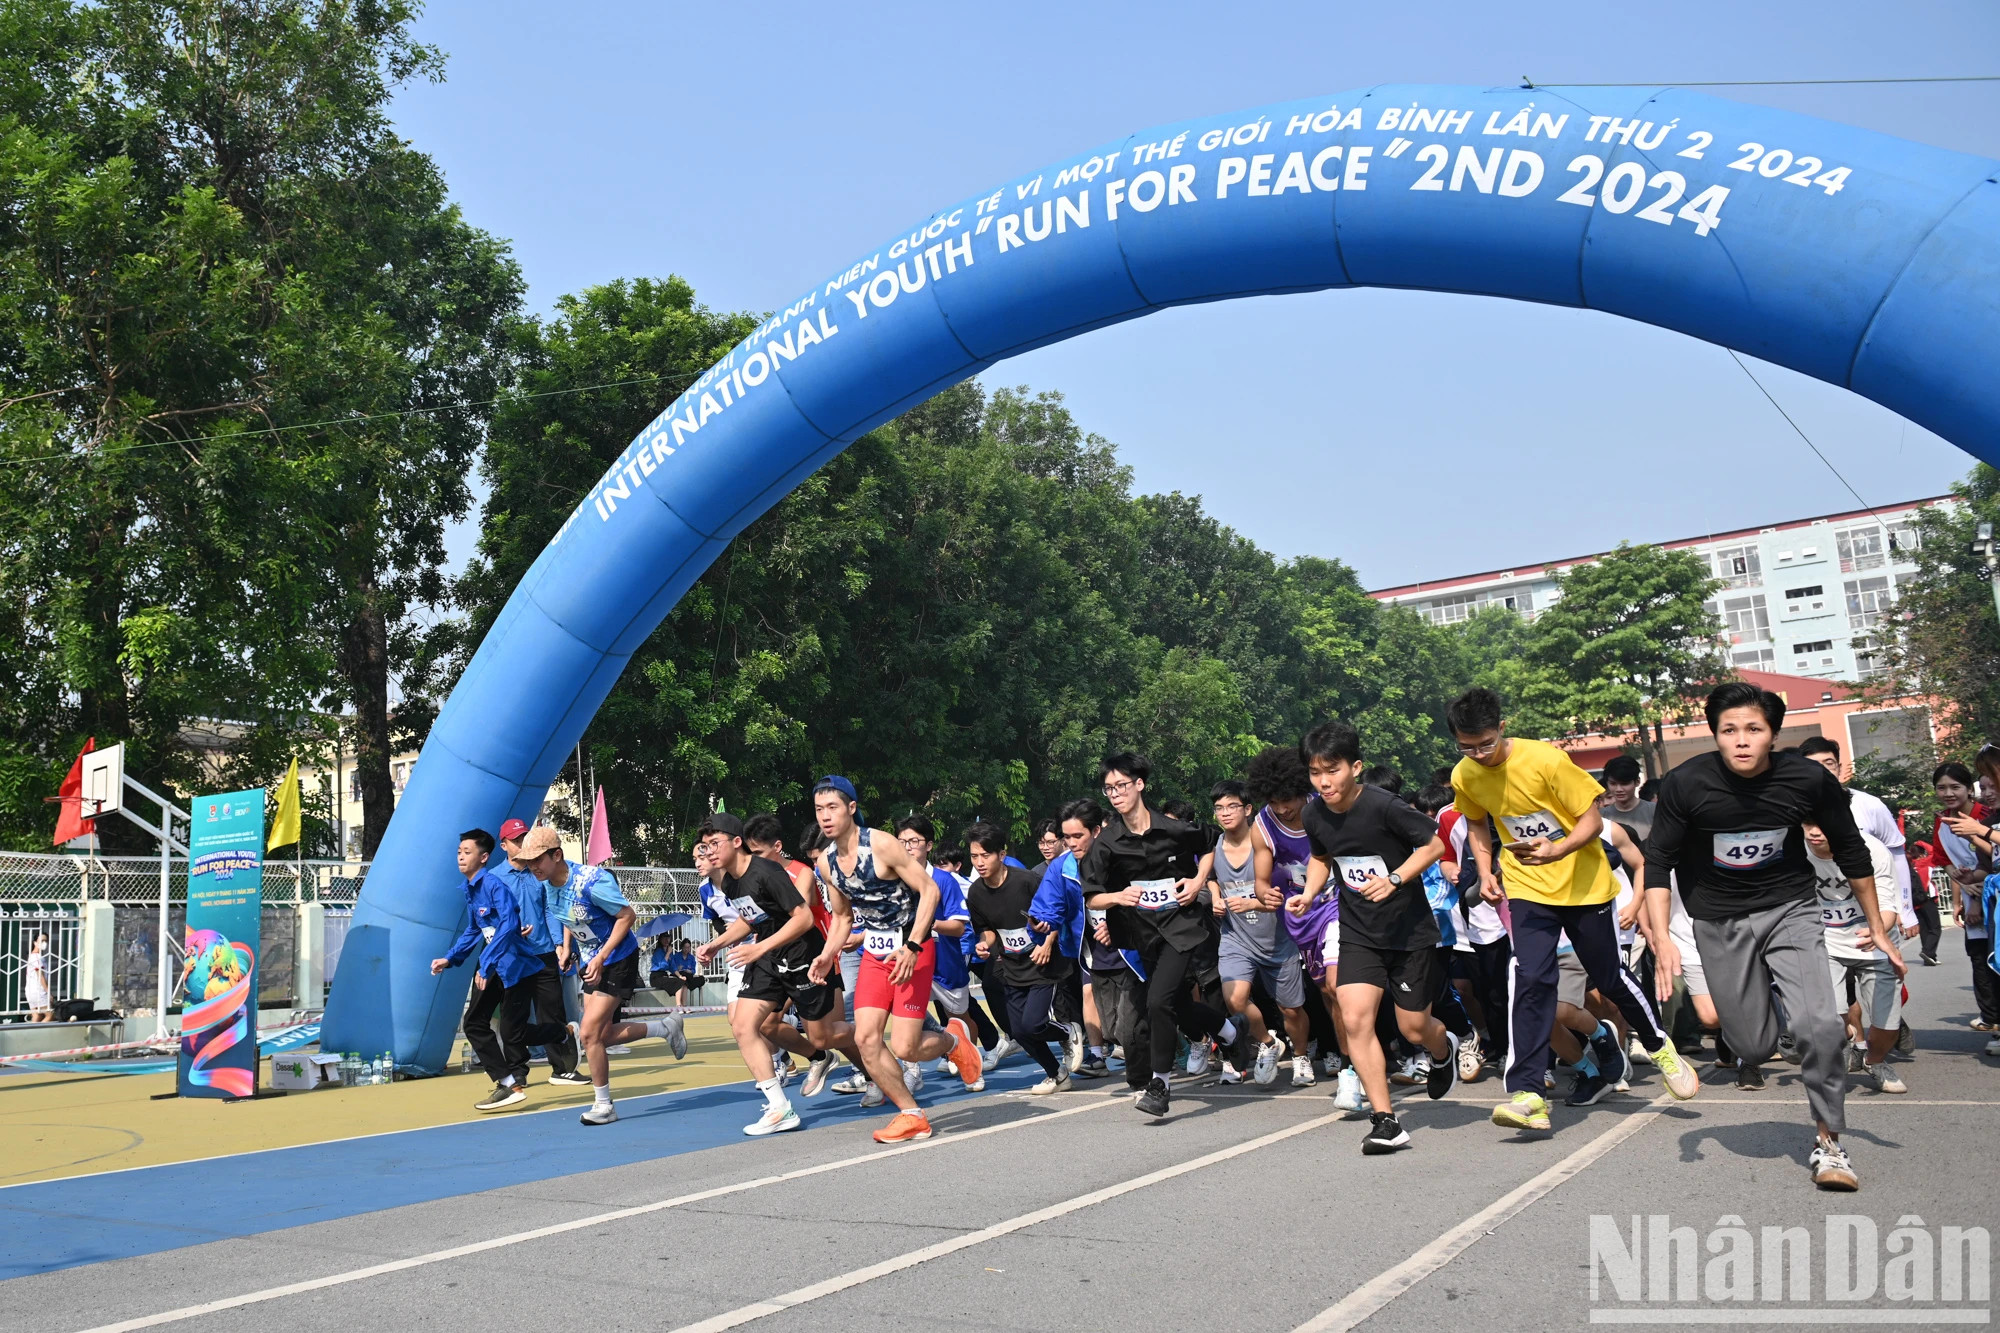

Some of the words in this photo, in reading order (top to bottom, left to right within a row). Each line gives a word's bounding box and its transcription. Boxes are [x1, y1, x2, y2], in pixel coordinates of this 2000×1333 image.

[744, 291, 816, 353] THANH
[825, 253, 880, 297] NIÊN
[888, 208, 963, 259] QUỐC
[976, 188, 1005, 216] TẾ
[1053, 152, 1120, 190] MỘT
[1132, 130, 1190, 166] THẾ
[1198, 115, 1272, 152] GIỚI
[1285, 104, 1362, 136] HÒA
[1376, 102, 1473, 135] BÌNH
[1482, 102, 1570, 139] LẦN
[1584, 115, 1680, 151] THỨ
[1676, 131, 1714, 160] 2
[1726, 142, 1853, 196] 2024
[594, 307, 838, 522] INTERNATIONAL
[845, 231, 974, 320] YOUTH
[1105, 163, 1198, 222] FOR
[1556, 154, 1731, 238] 2024
[1514, 821, 1549, 838] 264
[195, 851, 237, 865] INTERNATIONAL
[237, 850, 257, 859] YOUTH
[1726, 843, 1774, 860] 495
[209, 860, 225, 871] FOR
[215, 869, 234, 880] 2024
[1142, 890, 1169, 903] 335
[1823, 907, 1858, 920] 512
[869, 936, 895, 950] 334
[1005, 936, 1026, 947] 028
